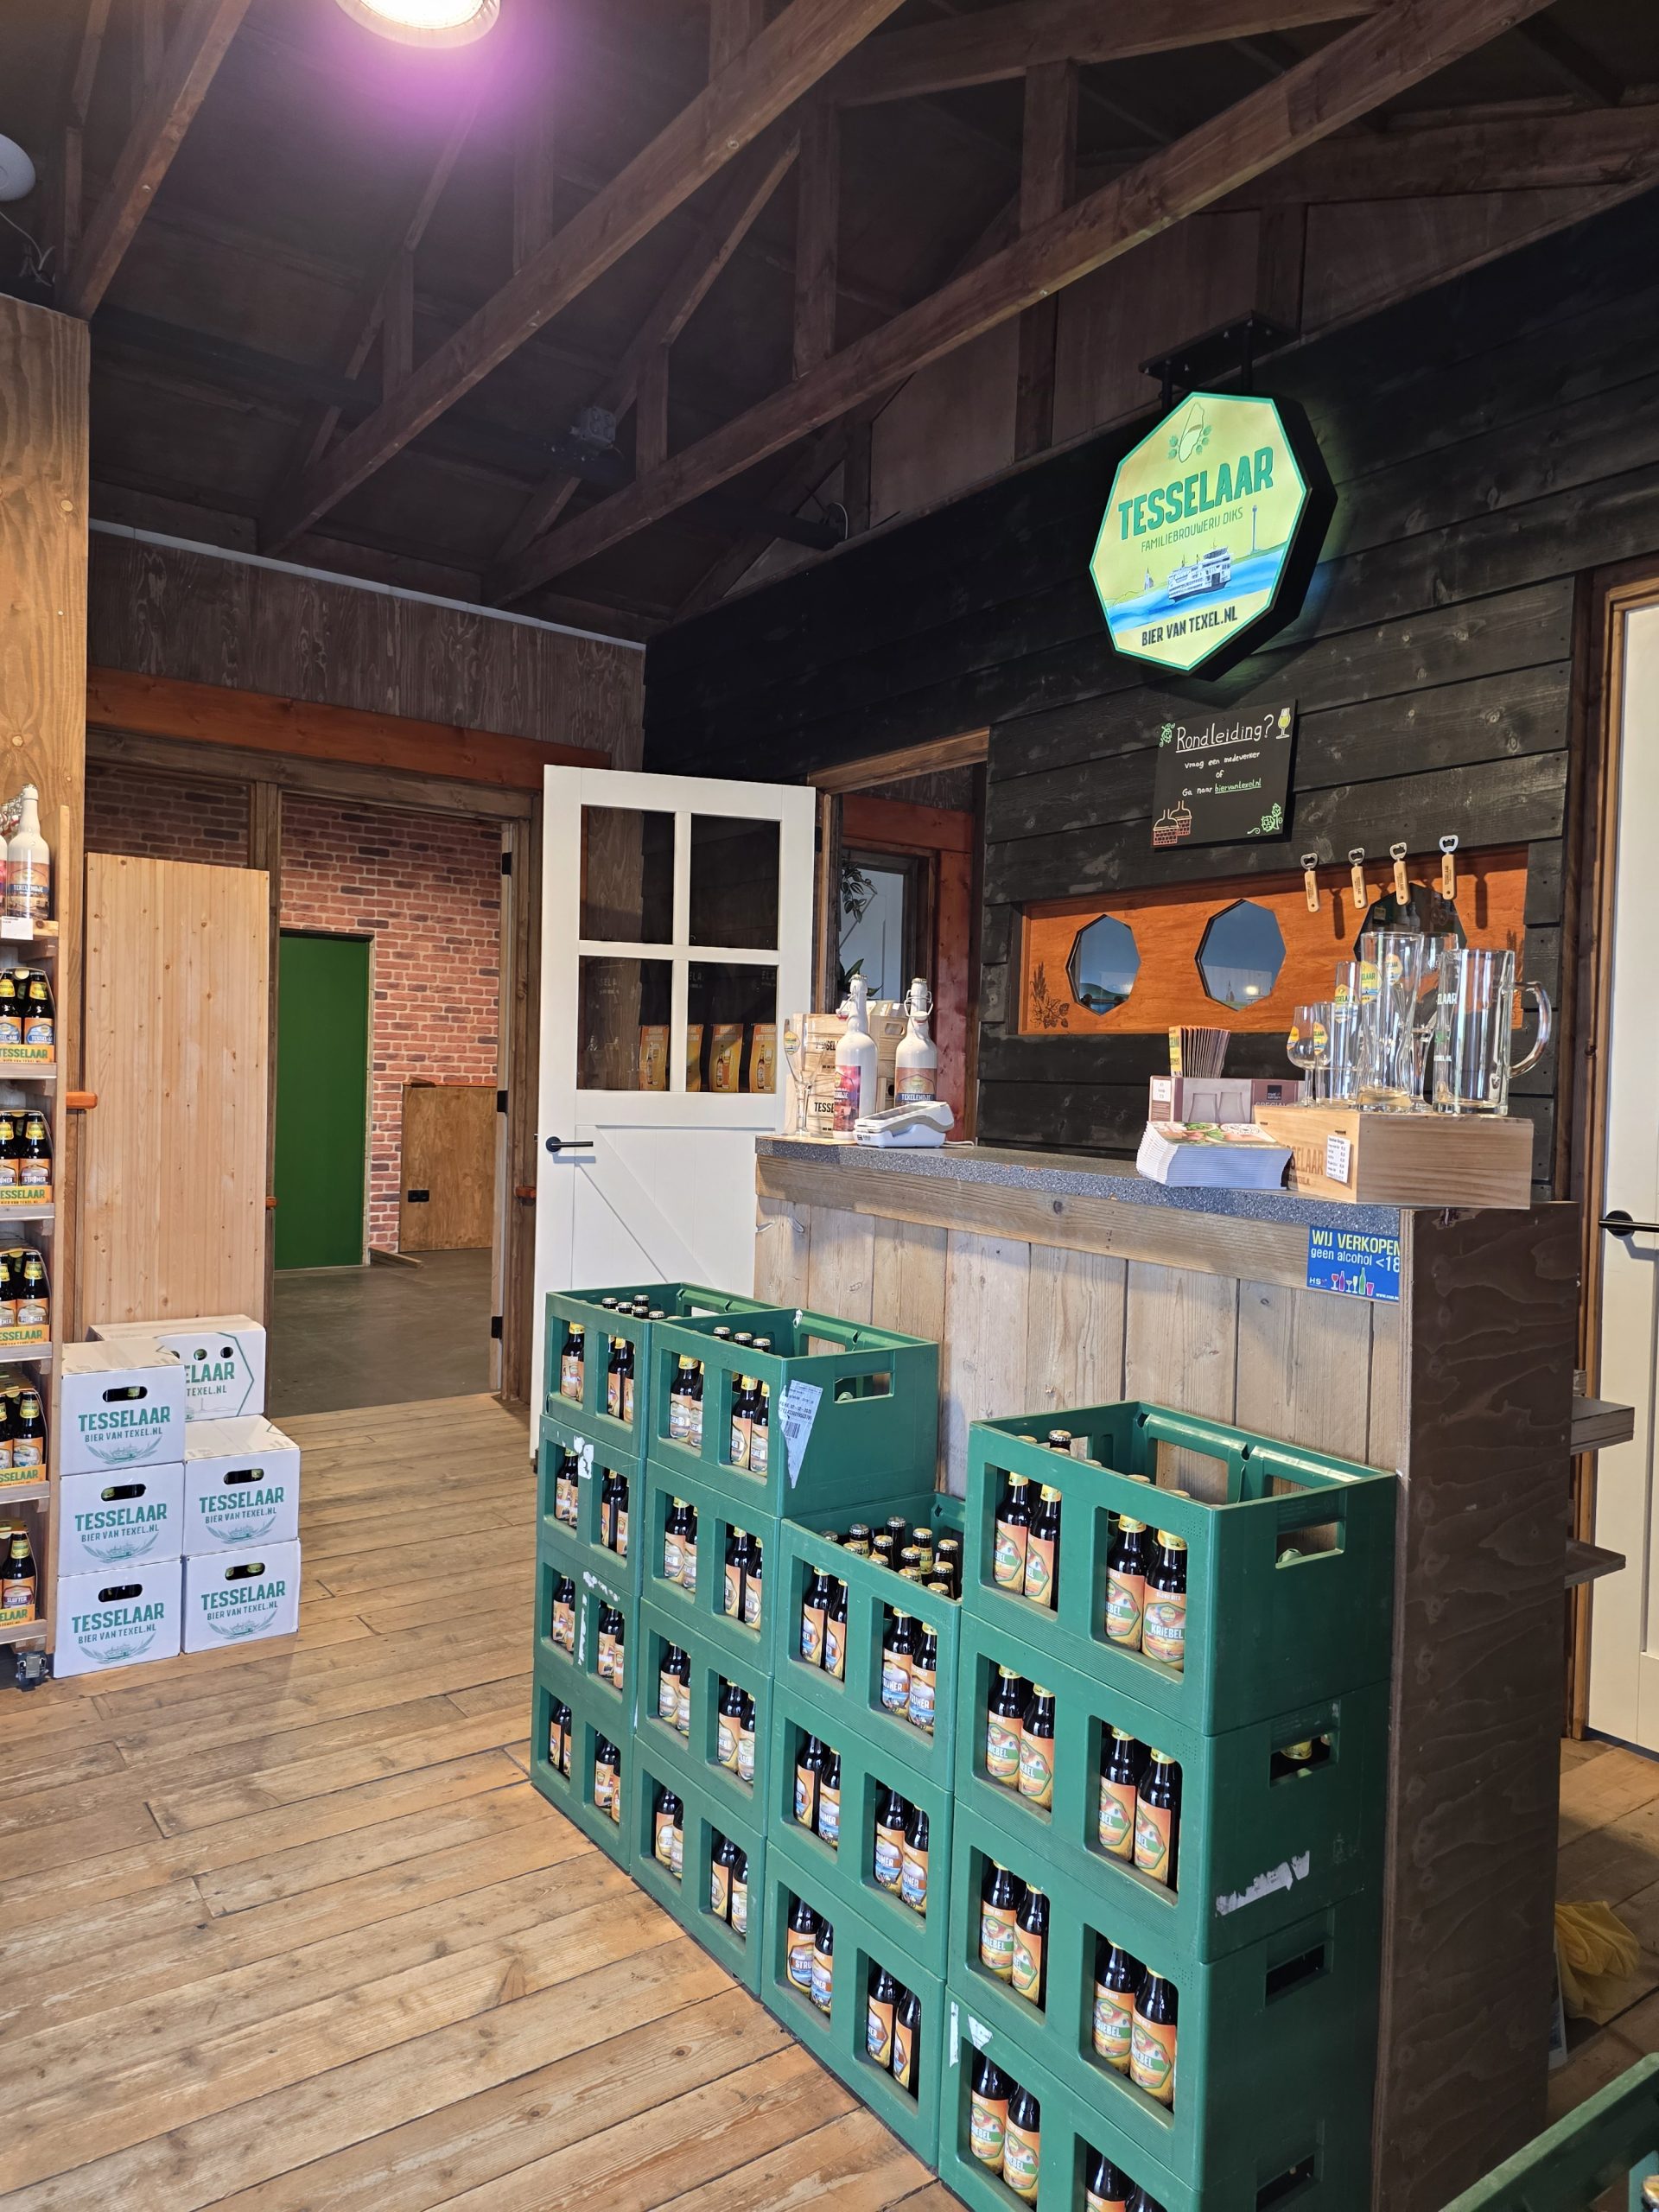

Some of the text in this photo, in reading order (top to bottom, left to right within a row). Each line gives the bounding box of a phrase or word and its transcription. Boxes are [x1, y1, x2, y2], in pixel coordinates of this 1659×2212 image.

[1117, 446, 1274, 541] TESSELAAR
[1141, 507, 1243, 553] FAMILIEBROUWERIJ DIKS
[1141, 605, 1238, 646] BIER VAN TEXEL.NL
[1176, 714, 1274, 751] Rondleiding?
[1184, 760, 1205, 769] vraag
[1224, 752, 1261, 763] medewerker
[1216, 769, 1224, 779] of
[1182, 788, 1192, 797] Ga
[1214, 778, 1262, 793] biervantexel.nl
[0, 1189, 45, 1198] ESSELAAR
[1312, 1229, 1332, 1247] WIJ
[1311, 1248, 1334, 1261] geen
[1337, 1251, 1372, 1266] alcohol
[0, 1330, 42, 1341] ESSELAAR
[185, 1362, 235, 1383] ELAAR
[187, 1384, 227, 1396] TEXEL.NL
[78, 1406, 171, 1432] TESSELAAR
[105, 1431, 123, 1440] VAN
[124, 1427, 162, 1438] TEXEL.NL
[0, 1470, 39, 1482] SSELAAR
[200, 1486, 284, 1514] TESSELAAR
[75, 1503, 167, 1532] TESSELAAR
[205, 1507, 276, 1524] BIER VAN TEXEL.NL
[81, 1523, 159, 1542] BIER VAN TEXEL.NL
[200, 1580, 286, 1611] TESSELAAR
[0, 1609, 28, 1622] ELAAR
[72, 1602, 165, 1634] TESSELAAR
[207, 1601, 278, 1620] BIER VAN TEXEL.NL
[78, 1624, 156, 1644] BIER VAN TEXEL.NL
[1150, 1624, 1184, 1639] KRIEBEL
